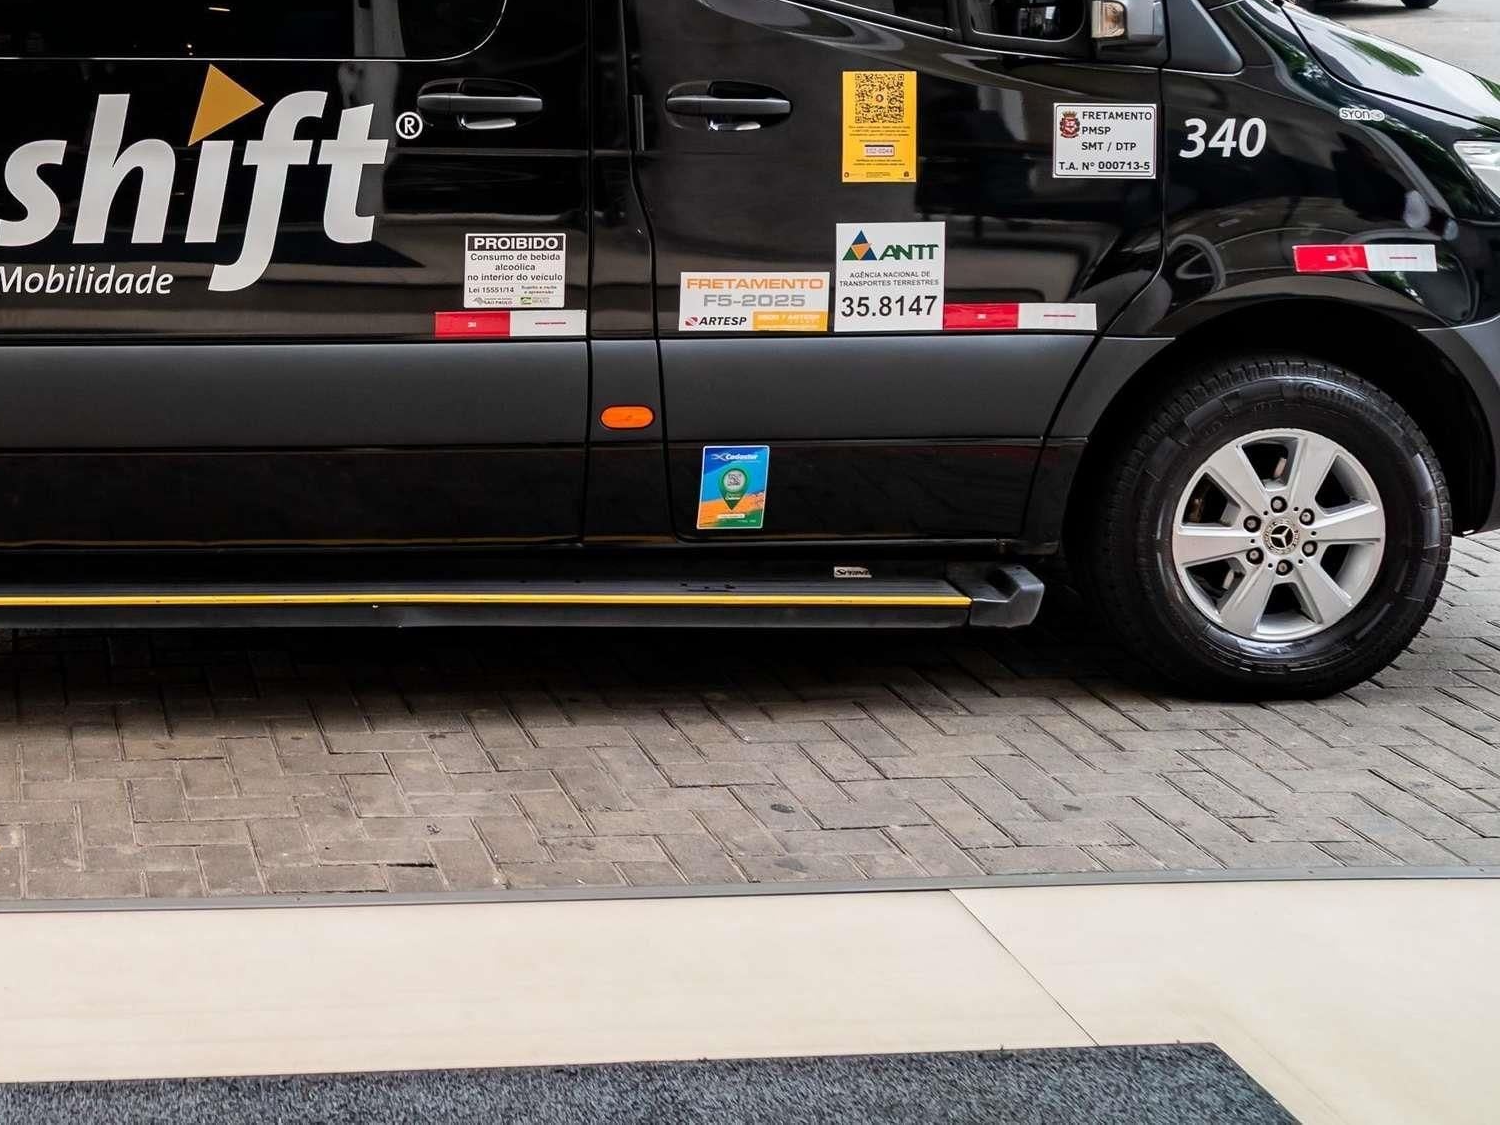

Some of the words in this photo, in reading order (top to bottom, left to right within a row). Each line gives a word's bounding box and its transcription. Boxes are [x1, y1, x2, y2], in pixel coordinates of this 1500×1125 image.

[1082, 111, 1152, 121] FRETAMENTO
[1081, 126, 1111, 135] PMSP
[1179, 117, 1268, 159] 340
[1081, 142, 1104, 151] SMT
[1107, 142, 1112, 152] /
[1116, 142, 1137, 151] DTP
[1059, 162, 1079, 171] T.A.
[1098, 161, 1150, 171] 000713-5
[473, 237, 559, 250] PROIBIDO
[470, 253, 514, 261] Consumo
[516, 253, 528, 261] de
[530, 253, 561, 261] bebida
[878, 244, 939, 261] ANTT
[481, 273, 514, 281] interior
[516, 273, 528, 281] do
[849, 270, 881, 279] AGÊNCIA
[686, 278, 824, 290] FRETAMENTO
[703, 294, 806, 307] F5-2025
[841, 295, 937, 317] 35.8147
[699, 316, 747, 326] ARTESP
